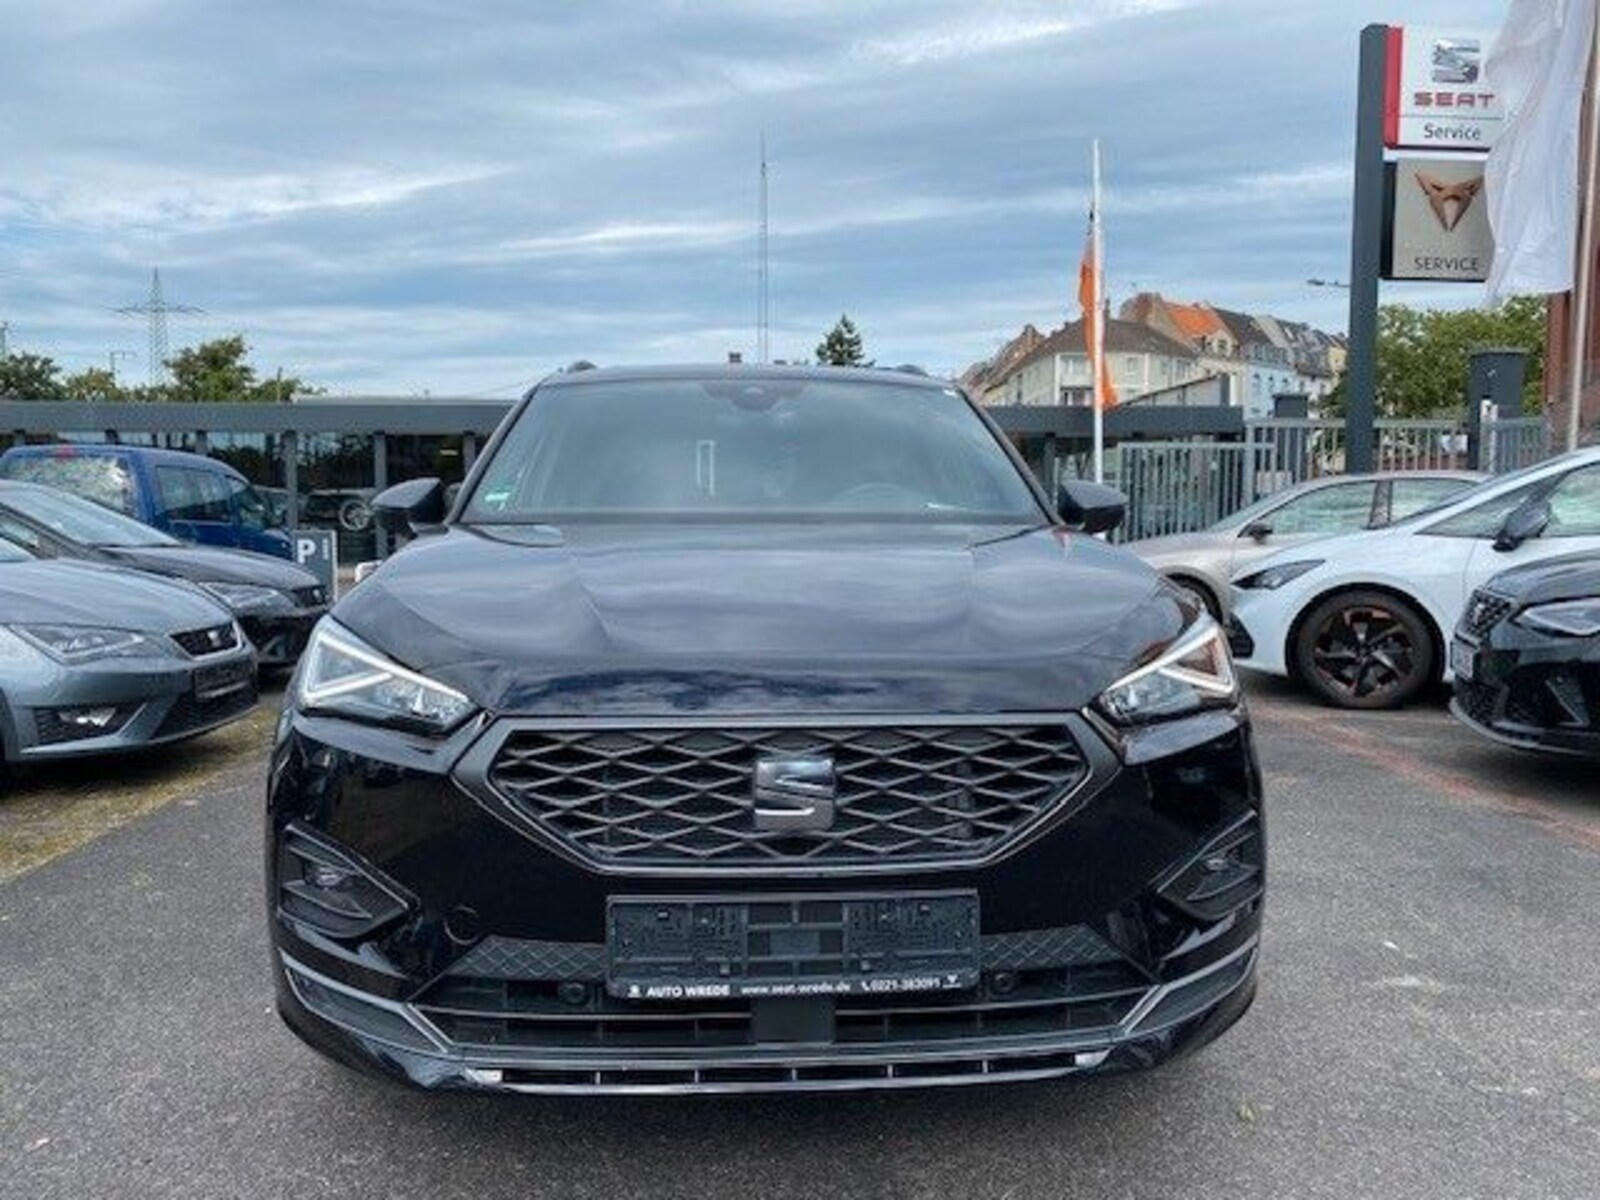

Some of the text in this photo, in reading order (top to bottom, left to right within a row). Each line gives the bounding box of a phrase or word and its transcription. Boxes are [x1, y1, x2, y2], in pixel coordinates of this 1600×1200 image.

[1414, 92, 1495, 108] SEAT
[1424, 123, 1481, 140] Service
[1415, 257, 1479, 271] SERVICE
[297, 539, 316, 563] P
[646, 984, 683, 998] AUTO
